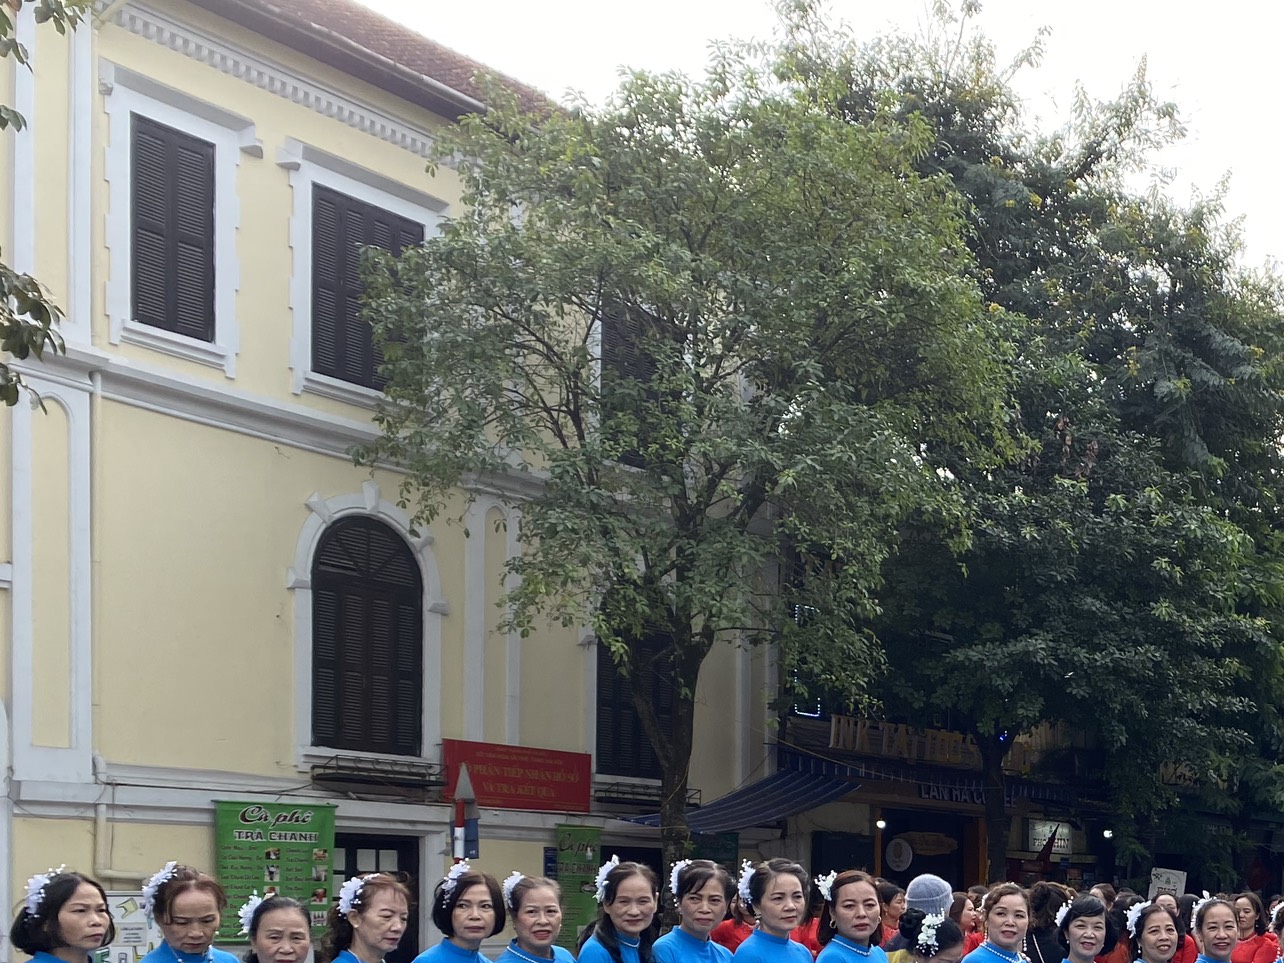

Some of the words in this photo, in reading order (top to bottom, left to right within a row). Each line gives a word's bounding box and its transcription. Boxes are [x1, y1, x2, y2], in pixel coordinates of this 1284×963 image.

[921, 783, 948, 801] LAN
[973, 789, 1017, 807] CEE
[239, 804, 270, 825] Cà
[268, 809, 315, 829] phê
[268, 831, 319, 843] CHANH
